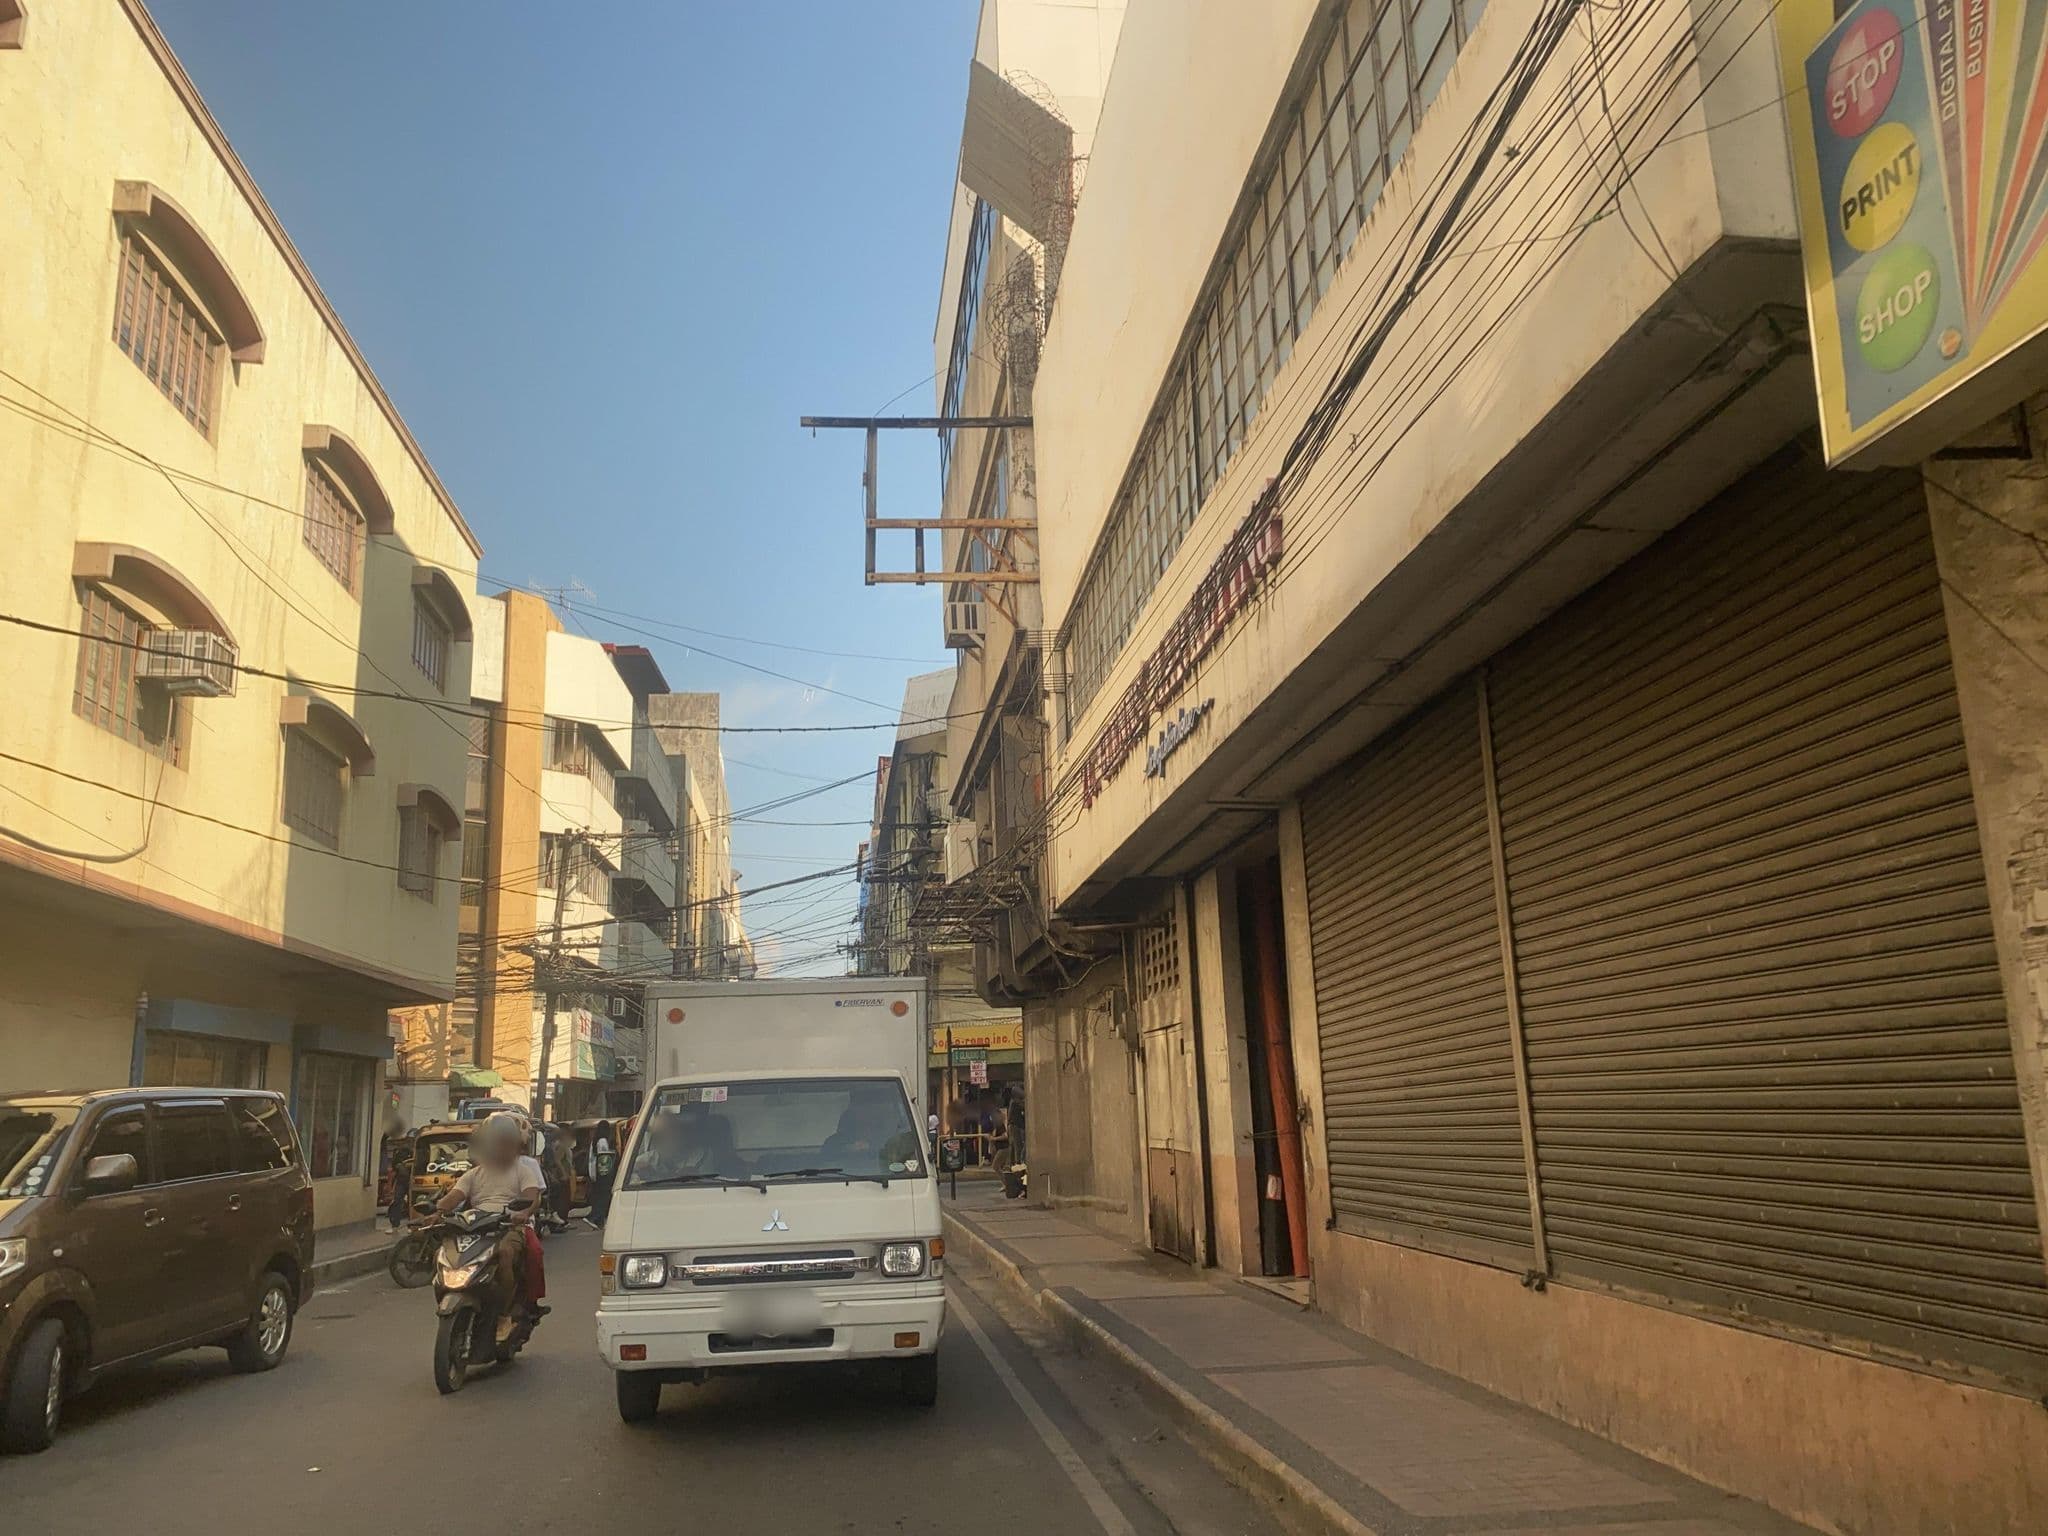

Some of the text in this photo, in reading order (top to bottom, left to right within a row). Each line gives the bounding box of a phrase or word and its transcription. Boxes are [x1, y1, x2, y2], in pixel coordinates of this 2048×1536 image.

[1832, 39, 1895, 120] STOP
[1938, 0, 1956, 122] DIGITAL P
[1842, 143, 1916, 230] PRINT
[1860, 270, 1931, 344] SHOP
